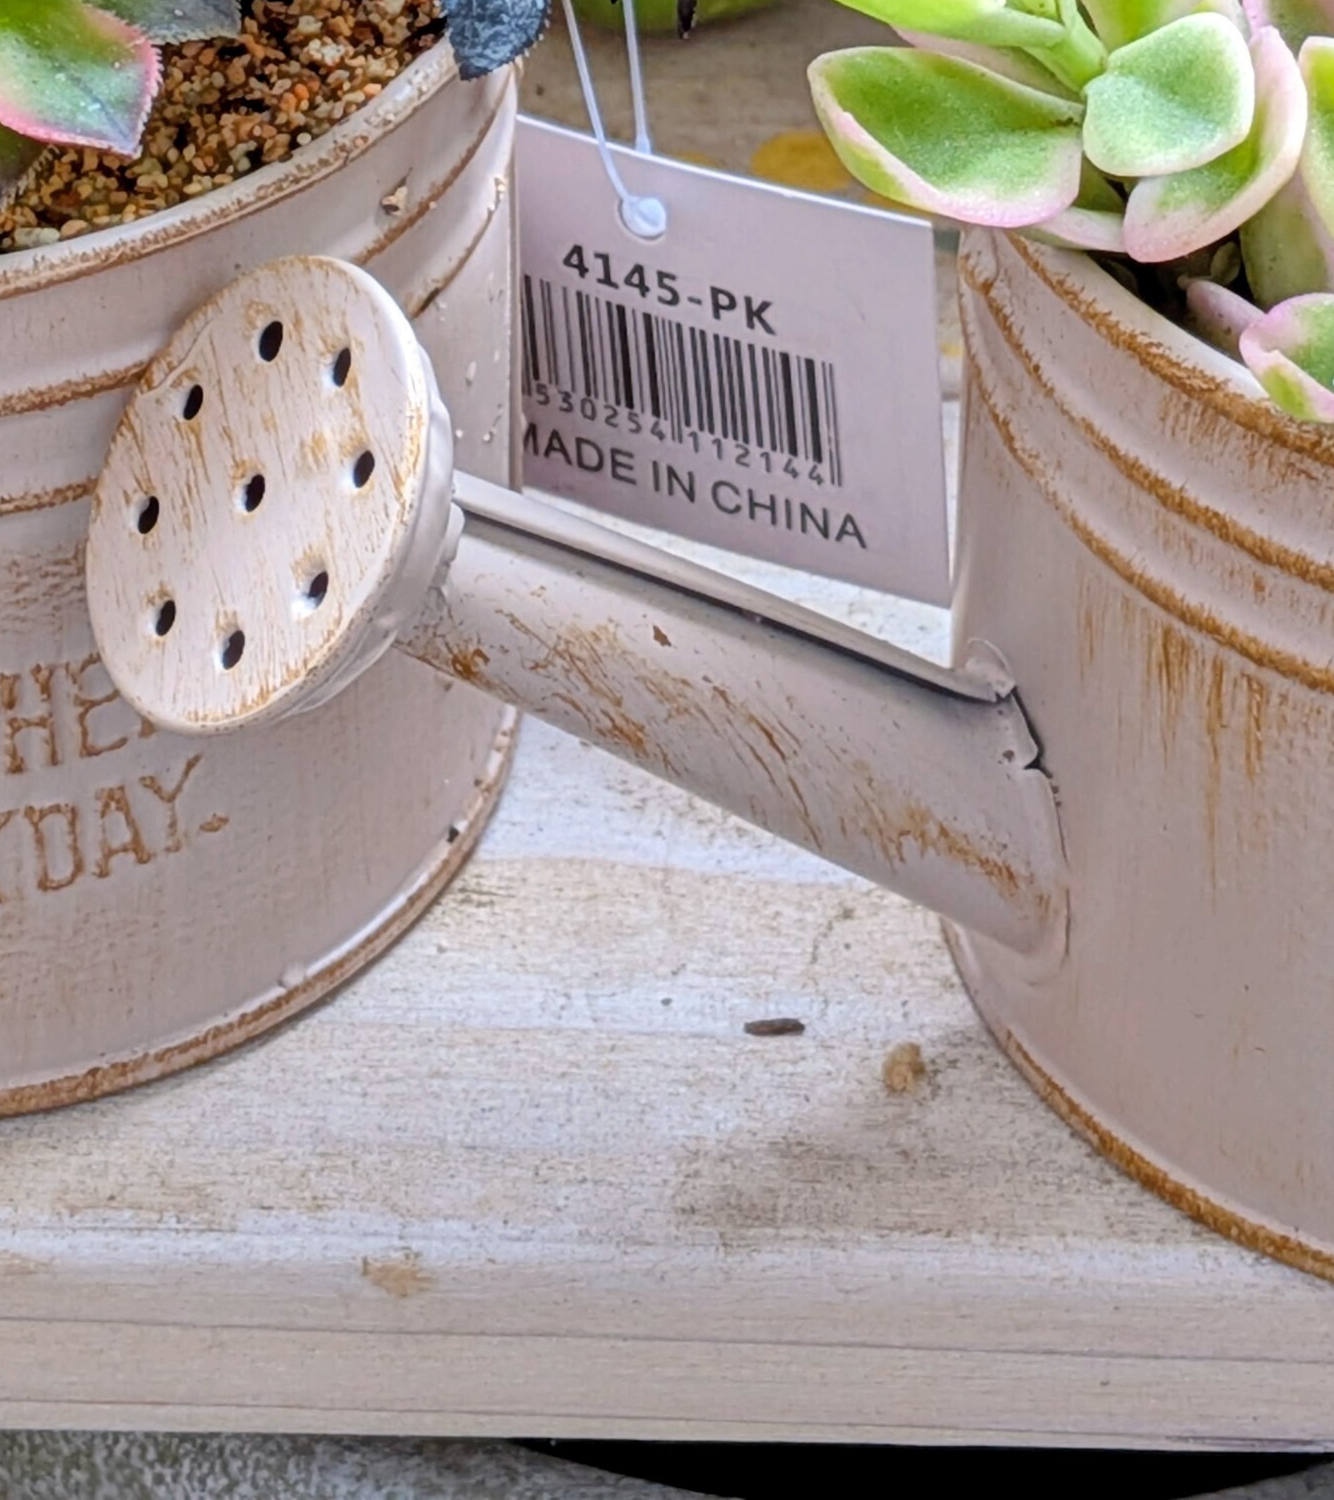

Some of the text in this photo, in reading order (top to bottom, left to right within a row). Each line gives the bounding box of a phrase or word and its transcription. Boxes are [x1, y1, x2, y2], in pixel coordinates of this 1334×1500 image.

[563, 243, 776, 336] 4145-PK
[651, 460, 696, 504] IN
[711, 479, 867, 550] CHINA
